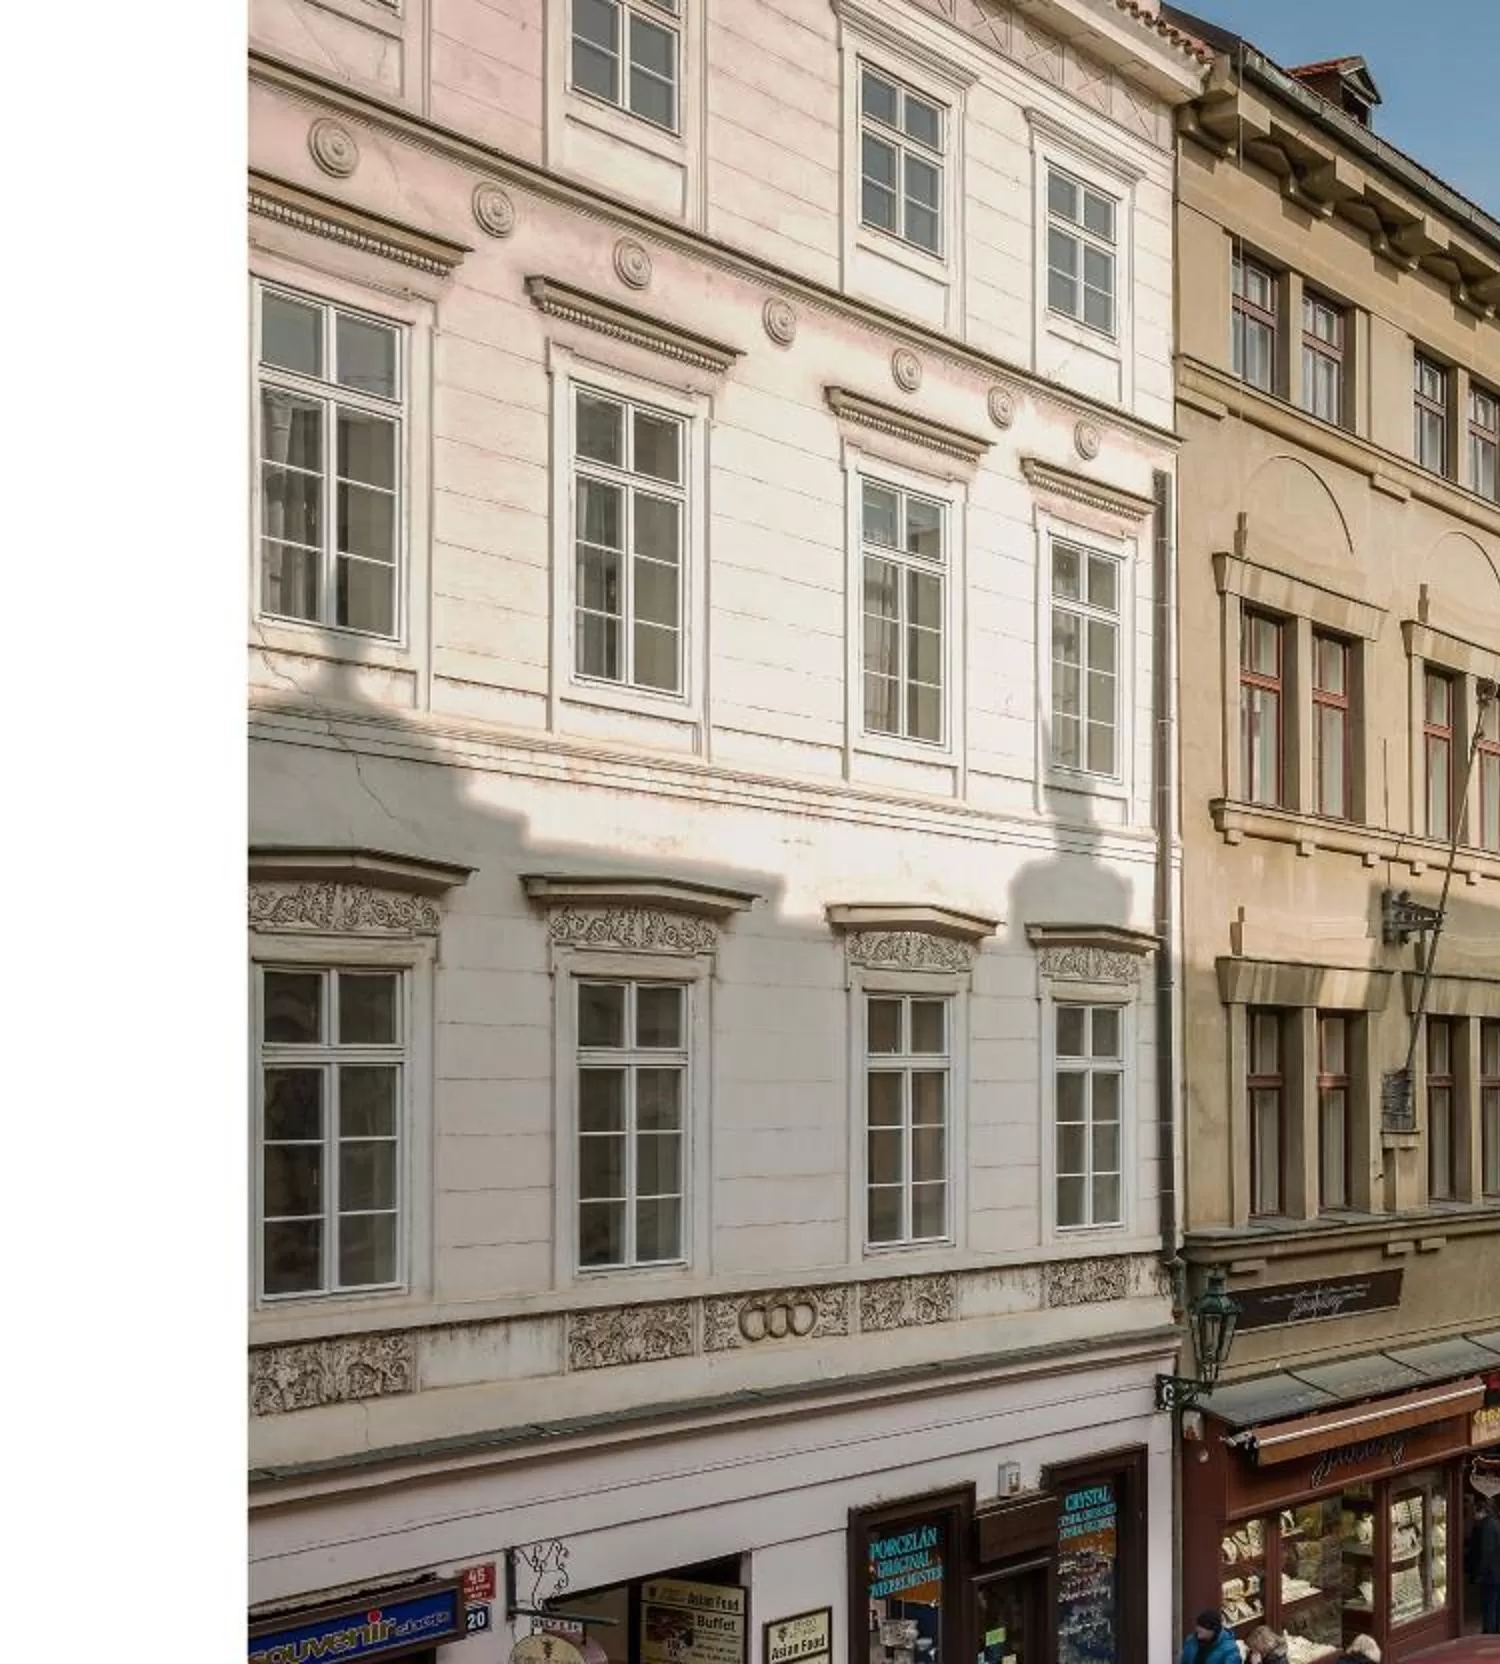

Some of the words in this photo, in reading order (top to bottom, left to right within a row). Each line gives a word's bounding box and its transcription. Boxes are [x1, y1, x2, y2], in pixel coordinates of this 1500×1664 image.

[467, 1611, 485, 1630] 20
[697, 1615, 736, 1633] Buffet
[771, 1643, 799, 1661] Asian
[801, 1633, 825, 1653] Food
